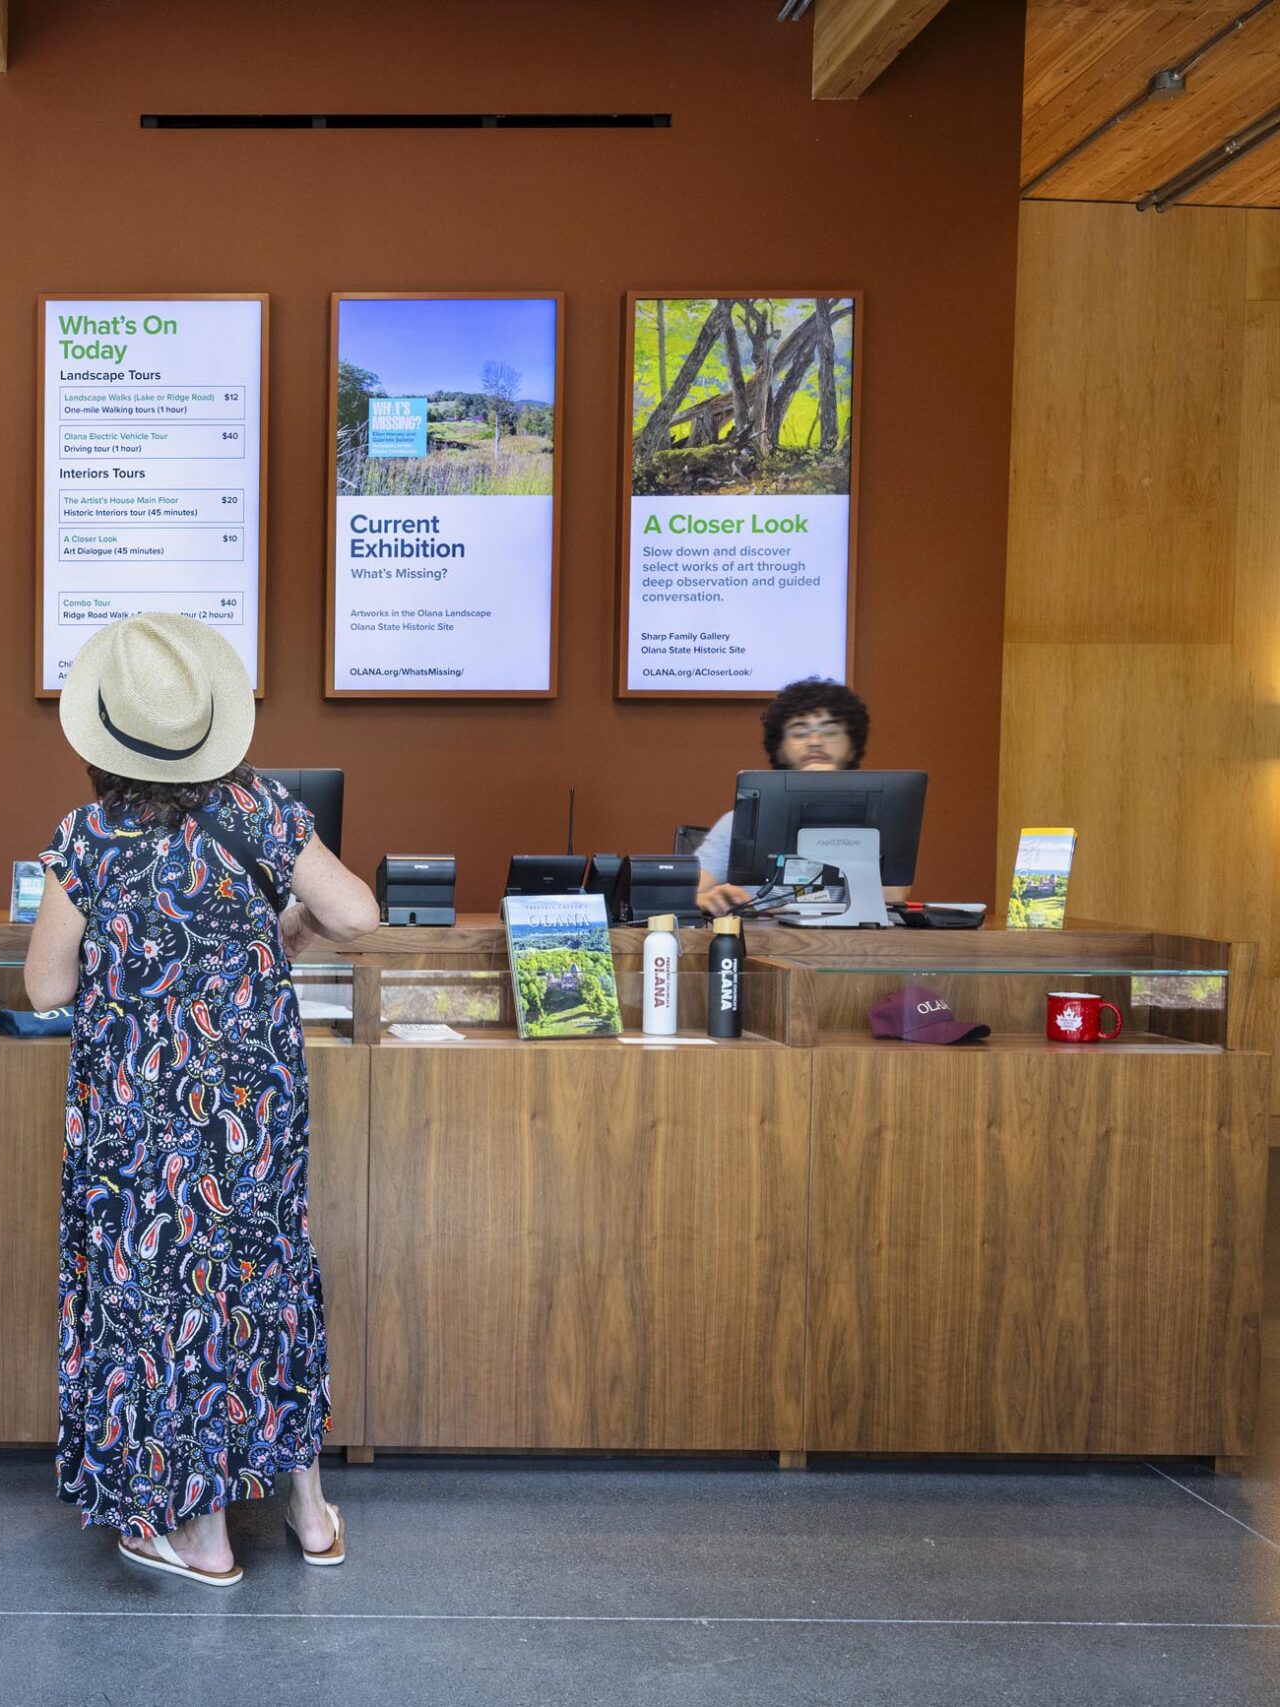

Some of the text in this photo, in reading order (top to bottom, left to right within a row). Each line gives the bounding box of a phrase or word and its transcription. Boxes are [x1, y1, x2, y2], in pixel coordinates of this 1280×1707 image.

[59, 315, 177, 335] What's On
[59, 340, 127, 364] Today
[60, 370, 161, 382] Landscape Tours
[64, 394, 106, 403] Landscape
[108, 394, 132, 402] Walks
[133, 394, 155, 403] (Lake
[167, 394, 190, 403] Ridge
[191, 394, 215, 403] Road)
[224, 393, 239, 402] $12
[64, 406, 100, 414] One-mile
[102, 406, 133, 415] Walking
[157, 406, 165, 415] (1
[166, 406, 187, 415] hour)
[372, 415, 422, 430] MISSING?
[64, 432, 239, 441] Olana Electric Vehicle Tour $40
[64, 445, 93, 454] Driving
[112, 445, 119, 454] (1
[120, 445, 142, 454] hour)
[59, 468, 146, 479] Interiors Tours
[64, 496, 238, 505] The Artist's House Main Floor $20
[64, 508, 198, 518] Historic Interiors tour (45 minutes)
[350, 514, 440, 534] Current
[643, 513, 809, 534] A Closer Look
[64, 535, 238, 543] A Closer Look $10
[64, 547, 165, 556] Art Dialogue (45 minutes)
[350, 538, 465, 558] Exhibition
[643, 546, 791, 557] Slow down and discover
[642, 561, 806, 574] select works of art through
[351, 568, 448, 581] What's Missing?
[642, 576, 820, 589] deep observation and guided
[642, 591, 724, 602] conversation.
[63, 598, 237, 608] Combo Tour $40
[63, 611, 86, 620] Ridge
[87, 611, 108, 619] Road
[109, 611, 129, 619] Walk
[198, 610, 208, 619] (2
[209, 610, 234, 619] hours)
[350, 609, 492, 619] Artworks in the Olana Landscape
[350, 623, 454, 631] Olana State Historic Site
[641, 632, 730, 642] Sharp Family Gallery
[641, 645, 746, 654] Olana State Historic Site
[350, 668, 464, 677] OLANA.org/WhatsMissing/
[642, 668, 753, 678] OLANA.org/ACloserLook/
[528, 911, 591, 928] OLANA
[654, 957, 665, 1008] OLANA
[721, 958, 733, 1011] OLANA
